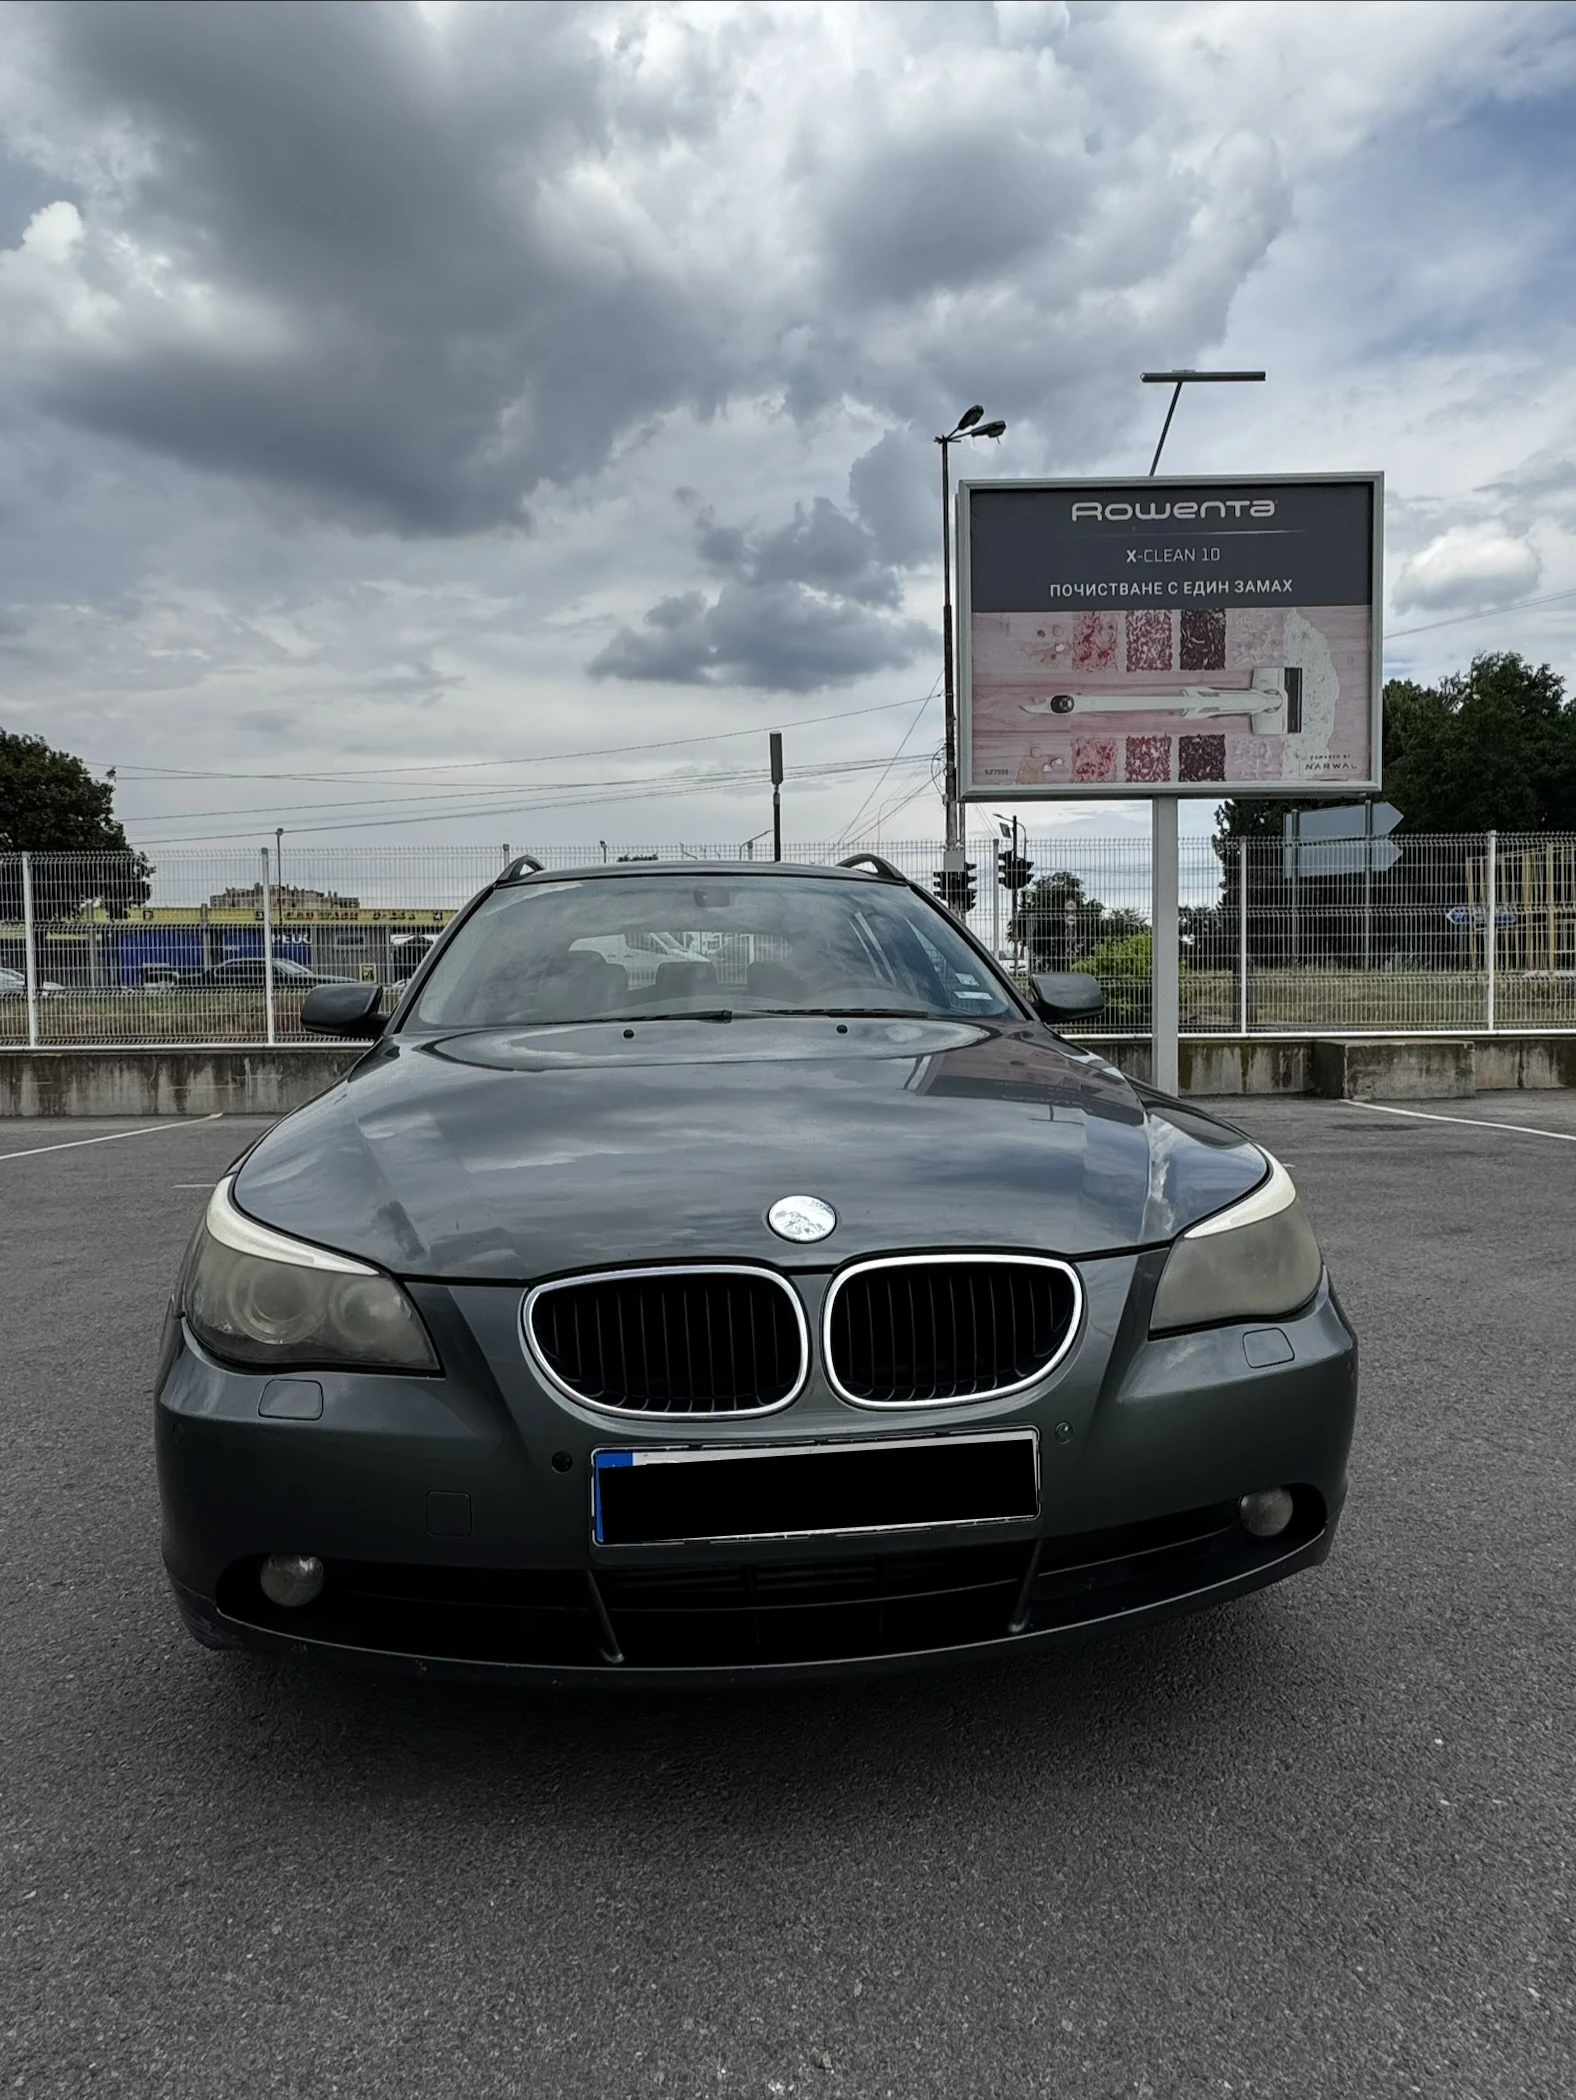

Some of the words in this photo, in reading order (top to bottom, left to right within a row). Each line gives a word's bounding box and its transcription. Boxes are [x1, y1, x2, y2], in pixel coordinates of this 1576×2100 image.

[1126, 549, 1196, 563] X-CLEAN
[1201, 548, 1221, 561] 10
[1050, 583, 1162, 597] ПОЧИСТВАНЕ
[1167, 582, 1179, 595] С
[1183, 580, 1229, 597] ЕДИН
[1234, 579, 1293, 593] ЗАМАХ
